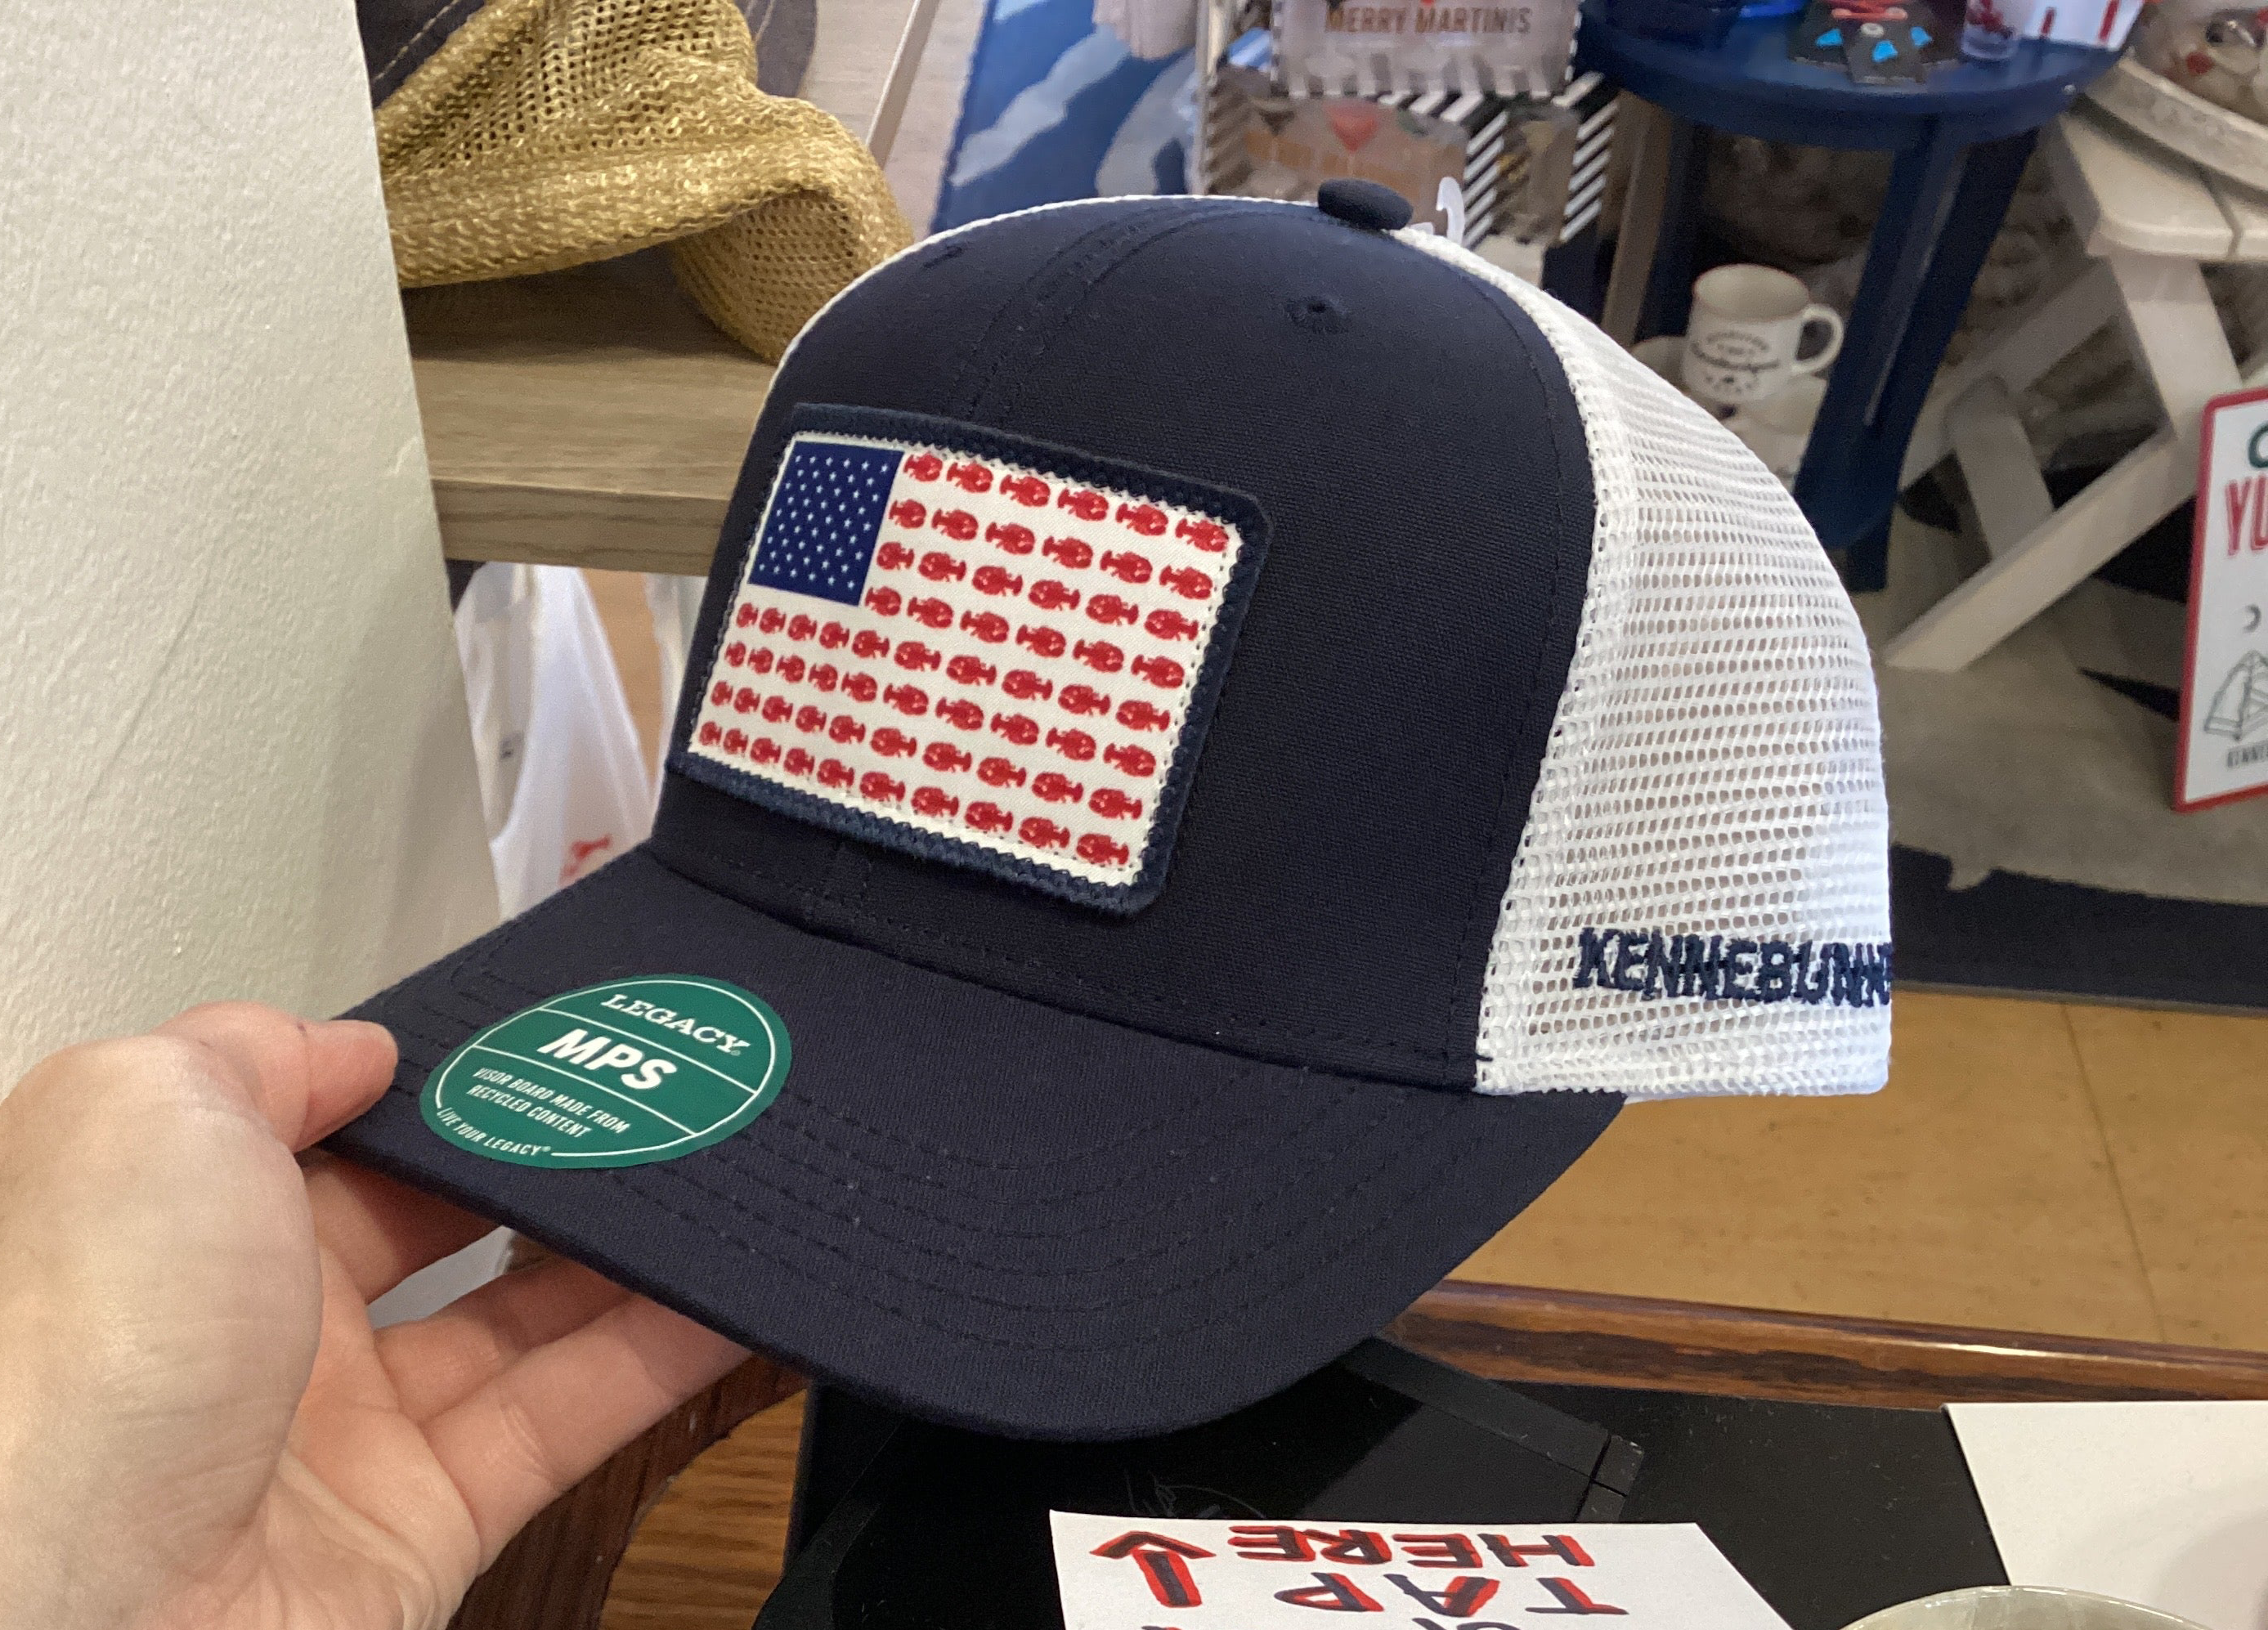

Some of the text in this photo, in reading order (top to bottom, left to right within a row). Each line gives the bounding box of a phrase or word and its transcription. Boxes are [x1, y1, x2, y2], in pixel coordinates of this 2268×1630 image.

[1325, 7, 1531, 33] MERRY MARTINIS
[536, 1028, 678, 1090] MPS
[466, 1084, 593, 1138] RECYCLED CONTENT
[473, 1068, 631, 1134] VISOR BOARD MADE FROM
[437, 1107, 459, 1127] LIVE
[453, 1123, 487, 1143] YOUR
[1227, 1525, 1595, 1569] HERE
[1274, 1571, 1629, 1617] TAP
